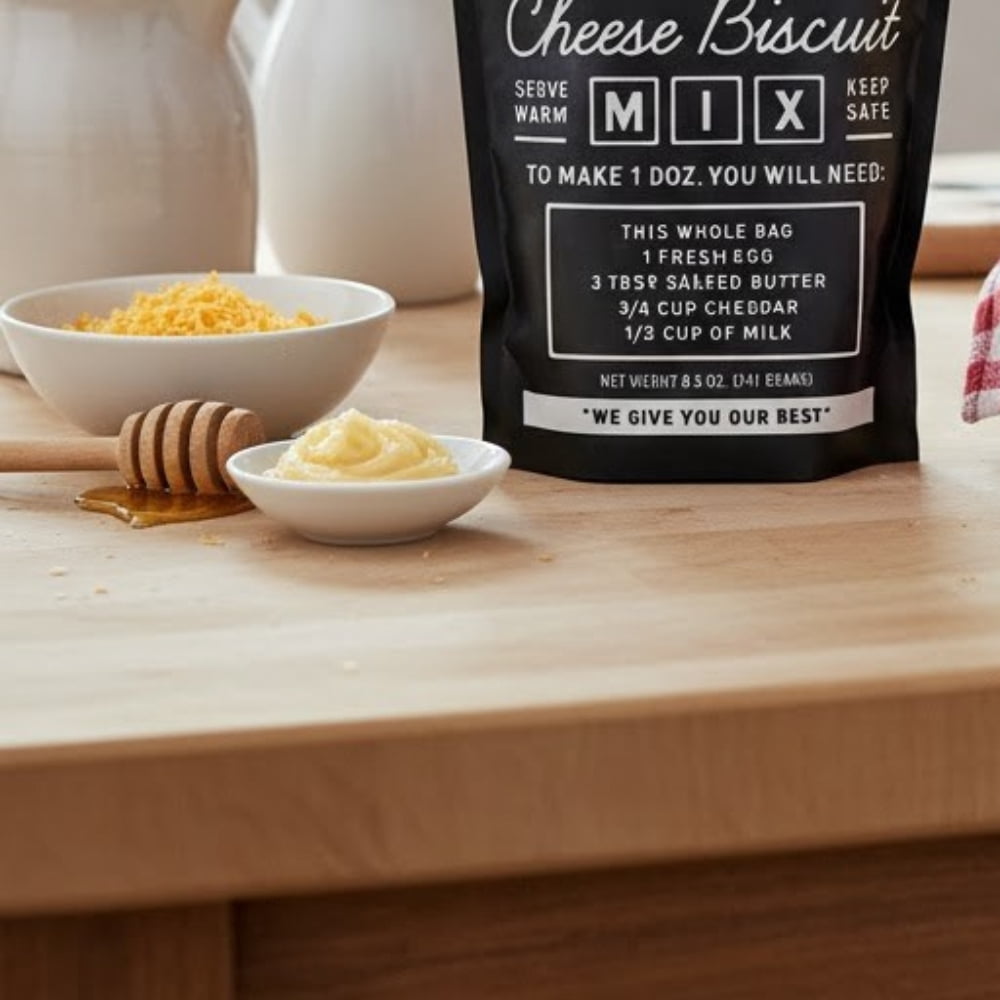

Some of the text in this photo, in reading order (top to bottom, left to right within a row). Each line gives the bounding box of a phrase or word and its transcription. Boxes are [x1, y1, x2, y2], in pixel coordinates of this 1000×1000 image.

[847, 77, 889, 96] KEEP
[515, 105, 567, 123] WARM
[847, 102, 889, 121] SAFE
[526, 164, 551, 184] TO
[558, 165, 622, 186] MAKE
[631, 166, 639, 185] 1
[709, 166, 756, 186] YOU
[764, 165, 822, 184] WILL
[828, 162, 885, 184] NEED:
[621, 224, 792, 240] THIS WHOLE BAG
[643, 248, 773, 265] 1 FRESH EGG
[591, 275, 601, 290] 3
[751, 273, 825, 289] BUTTER
[619, 300, 649, 319] 3/4
[658, 301, 696, 316] CUP
[625, 325, 791, 344] 1/3 CUP OF MILK
[629, 410, 672, 425] GIVE
[681, 410, 720, 425] YOU
[729, 410, 768, 425] OUR
